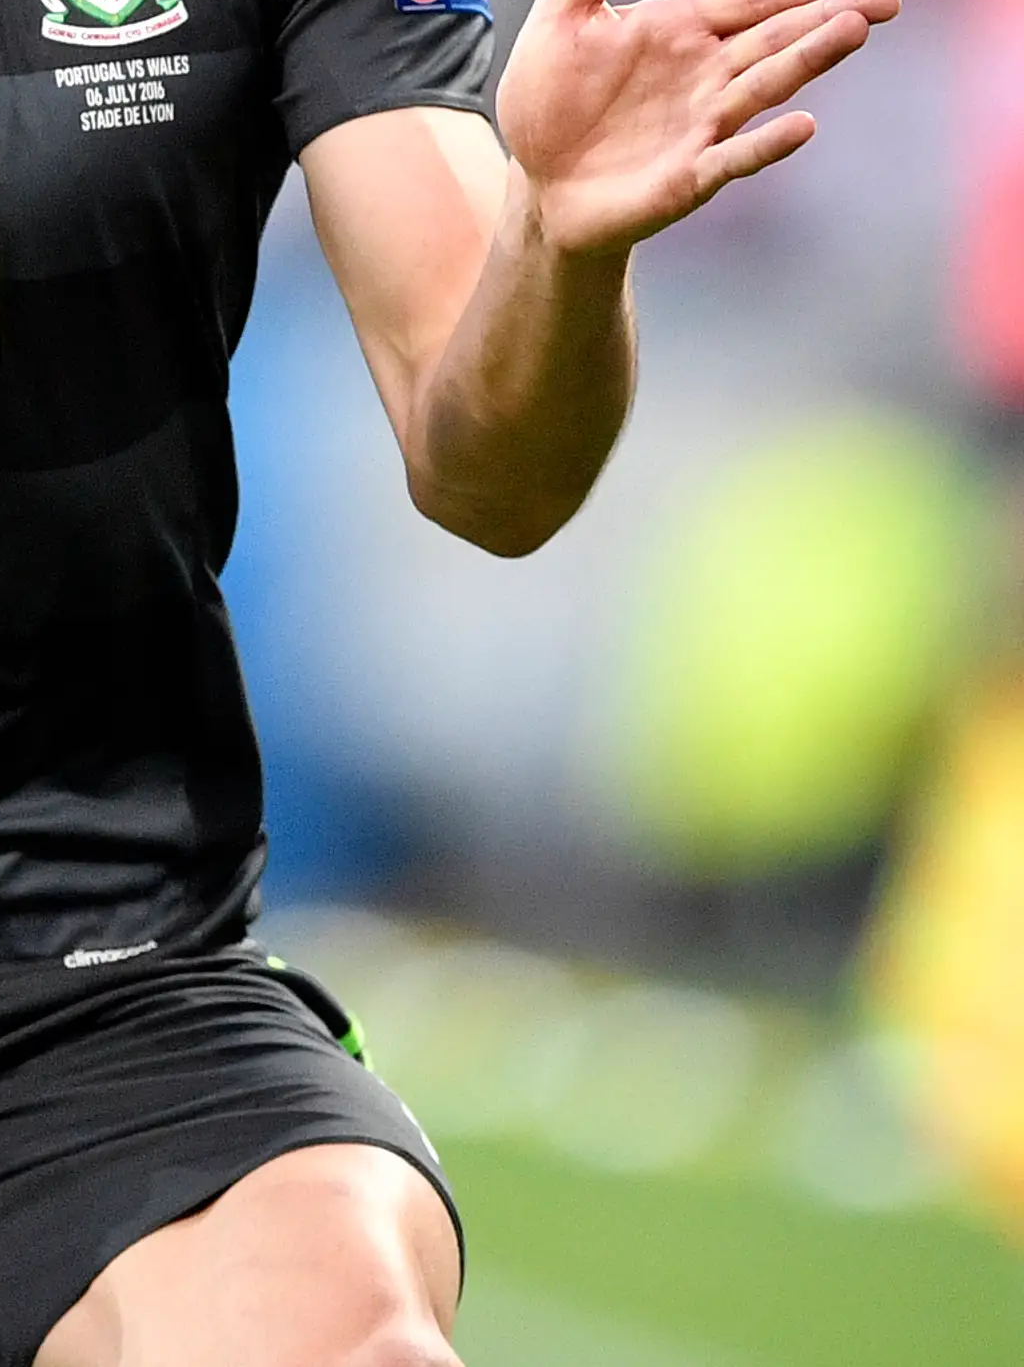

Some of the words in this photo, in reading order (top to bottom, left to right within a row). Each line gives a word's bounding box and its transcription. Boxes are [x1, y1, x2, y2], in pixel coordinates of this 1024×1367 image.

[55, 61, 126, 87] PORTUGAL
[126, 59, 145, 78] VS
[146, 55, 190, 77] WALES
[85, 87, 103, 107] 06
[104, 83, 136, 105] JULY
[138, 80, 165, 102] 2016
[80, 108, 122, 131] STADE
[123, 106, 141, 126] DE
[142, 103, 174, 124] LYON
